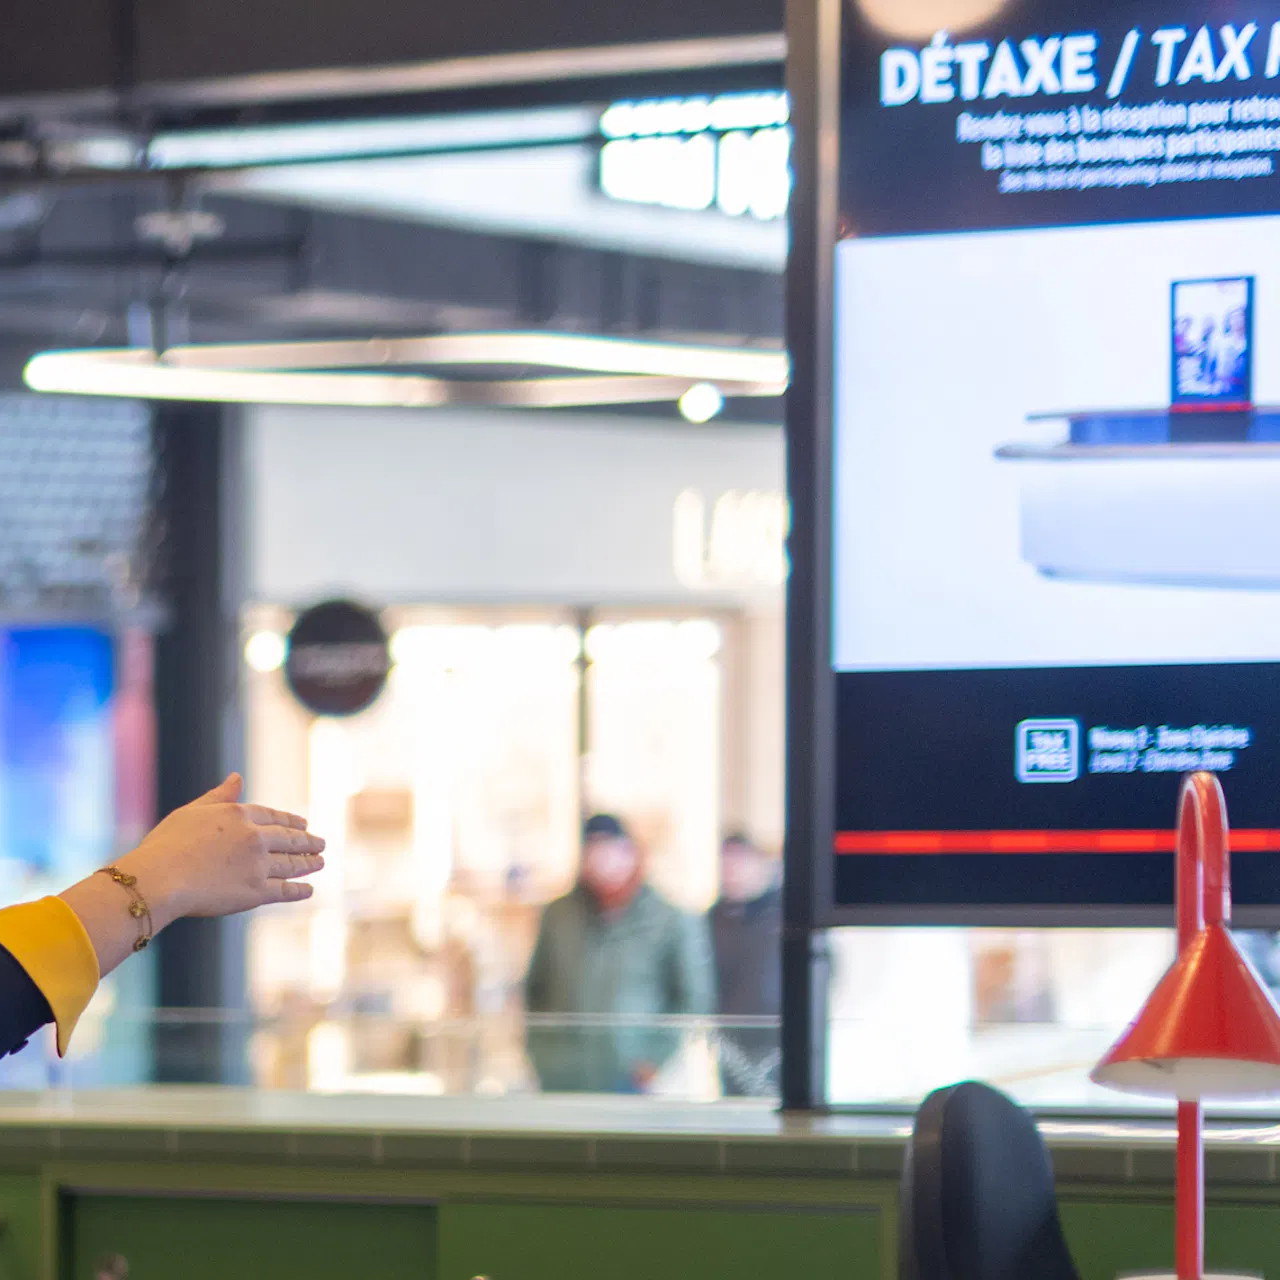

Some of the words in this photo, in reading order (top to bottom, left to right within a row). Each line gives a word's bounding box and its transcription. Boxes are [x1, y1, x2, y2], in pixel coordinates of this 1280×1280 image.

[880, 29, 1097, 107] DÉTAXE
[1106, 28, 1140, 99] /
[1151, 21, 1257, 87] TAX
[1030, 731, 1066, 750] TAX
[1027, 751, 1071, 771] FREE
